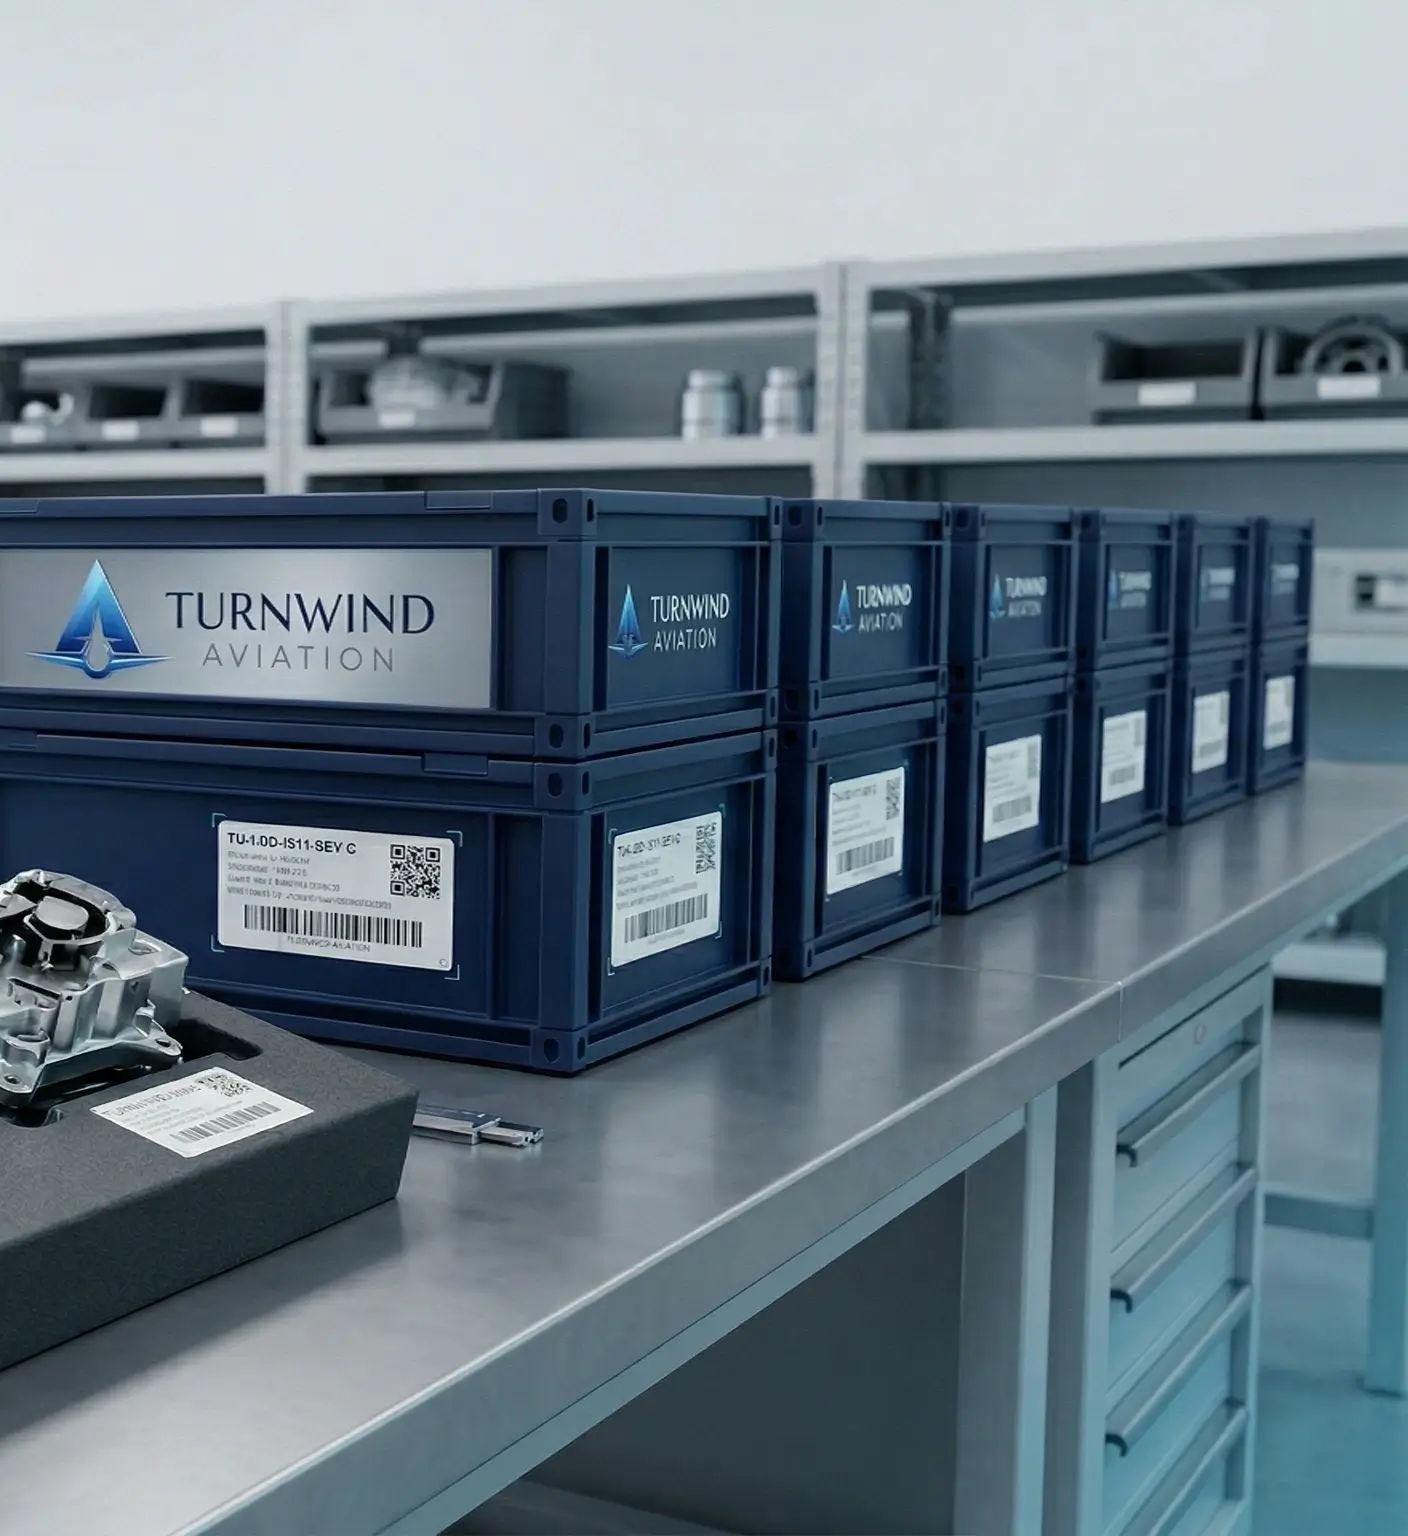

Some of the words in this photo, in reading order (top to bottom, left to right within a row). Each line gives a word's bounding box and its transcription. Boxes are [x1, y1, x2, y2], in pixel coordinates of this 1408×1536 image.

[165, 592, 435, 634] TURNWIND
[651, 593, 730, 622] TURNWIND
[653, 627, 717, 653] AVIATION
[202, 643, 393, 672] AVIATION
